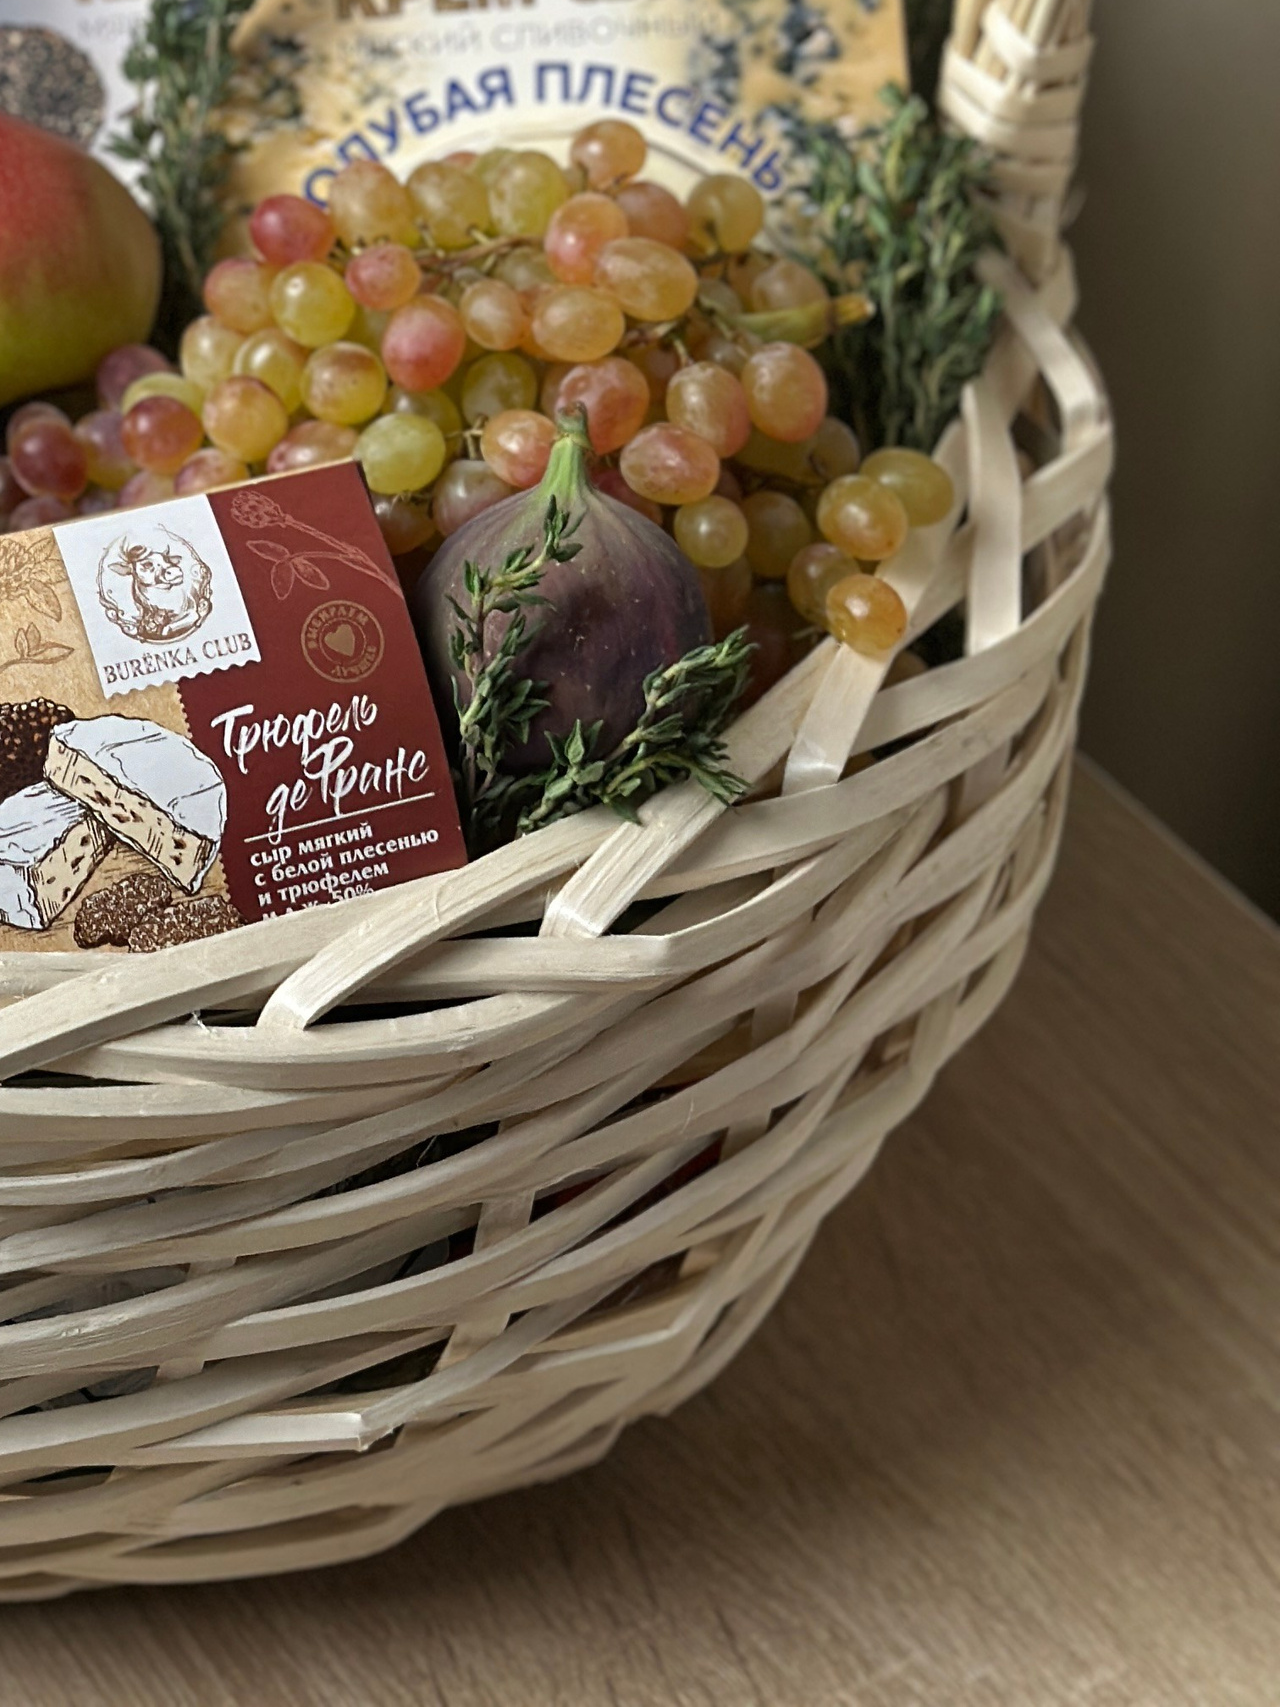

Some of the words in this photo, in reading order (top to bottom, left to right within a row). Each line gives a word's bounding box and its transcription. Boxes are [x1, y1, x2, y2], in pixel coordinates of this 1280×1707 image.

[303, 64, 515, 204] ОЛУБАЯ
[534, 60, 786, 192] ПЛЕСЕНЬ
[202, 632, 252, 660] CLUB
[210, 694, 379, 775] Трюфель
[265, 778, 314, 845] де
[304, 735, 431, 817] Франс
[250, 845, 292, 868] сыр
[297, 822, 373, 856] мягкий
[254, 871, 267, 887] с
[271, 852, 333, 882] белой
[339, 829, 440, 867] плесенью
[258, 892, 272, 907] и
[277, 861, 389, 905] трюфелем
